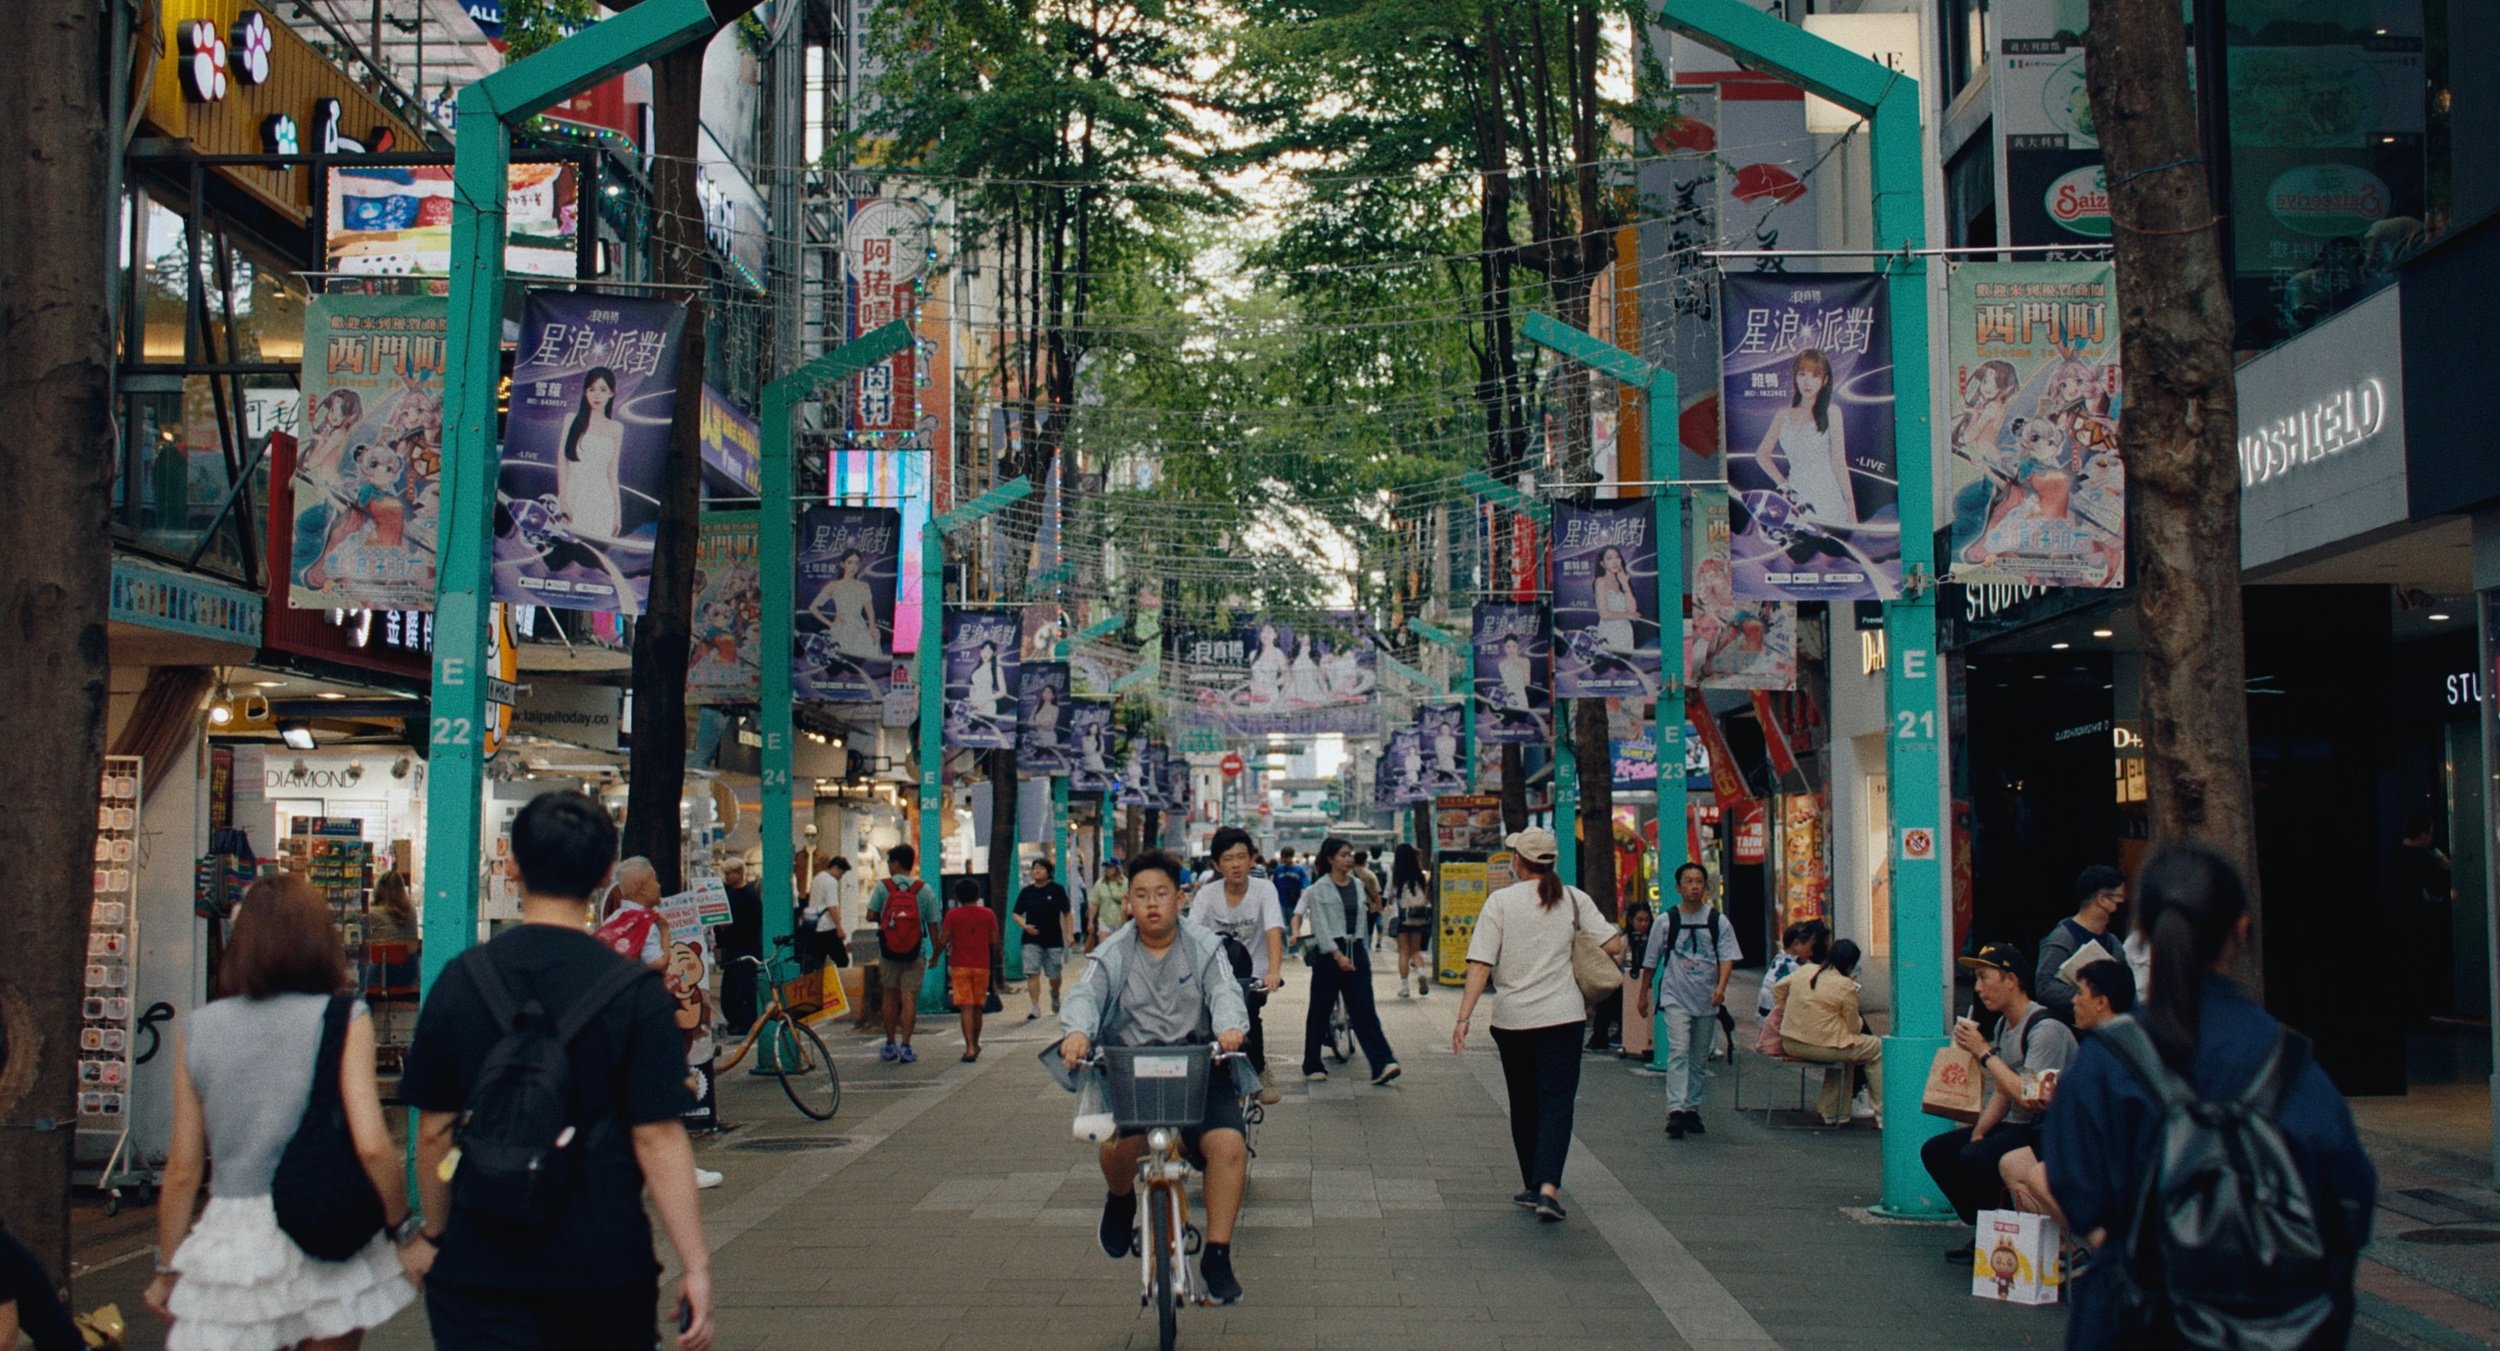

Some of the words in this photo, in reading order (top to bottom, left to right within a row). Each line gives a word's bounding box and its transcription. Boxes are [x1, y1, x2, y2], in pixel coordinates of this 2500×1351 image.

[1740, 306, 1875, 355] 星浪派對
[1975, 301, 2107, 345] 西門町
[327, 334, 447, 376] 西門町
[532, 323, 667, 377] 星浪派對
[1563, 517, 1647, 549] 星浪派對
[441, 658, 465, 686] E
[1903, 650, 1928, 679] E
[433, 717, 471, 745] 22
[1664, 726, 1679, 744] E
[1898, 710, 1934, 739] 21
[767, 732, 782, 750] E
[265, 769, 358, 789] DIAMOND
[763, 769, 786, 786] 24
[924, 771, 935, 785] E
[1560, 764, 1570, 777] E
[1661, 763, 1686, 780] 23
[921, 797, 938, 810] 26
